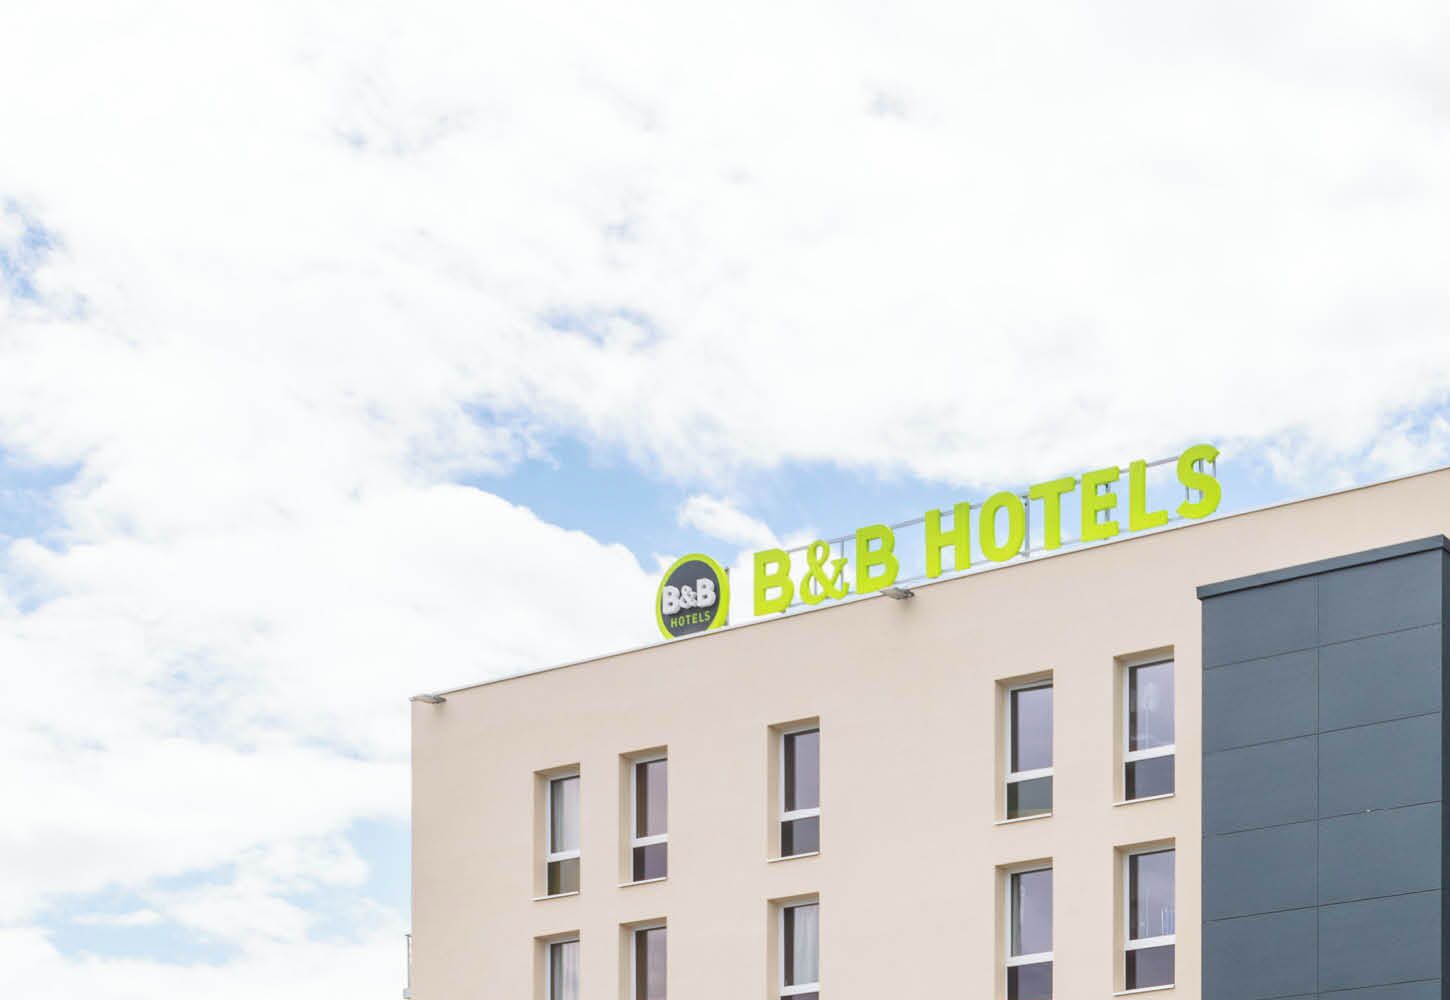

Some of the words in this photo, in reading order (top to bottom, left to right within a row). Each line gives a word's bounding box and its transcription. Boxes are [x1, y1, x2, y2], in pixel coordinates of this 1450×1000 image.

[753, 523, 900, 616] B&B
[924, 443, 1222, 578] HOTELS
[662, 578, 716, 615] B&B
[670, 610, 711, 628] HOTELS
